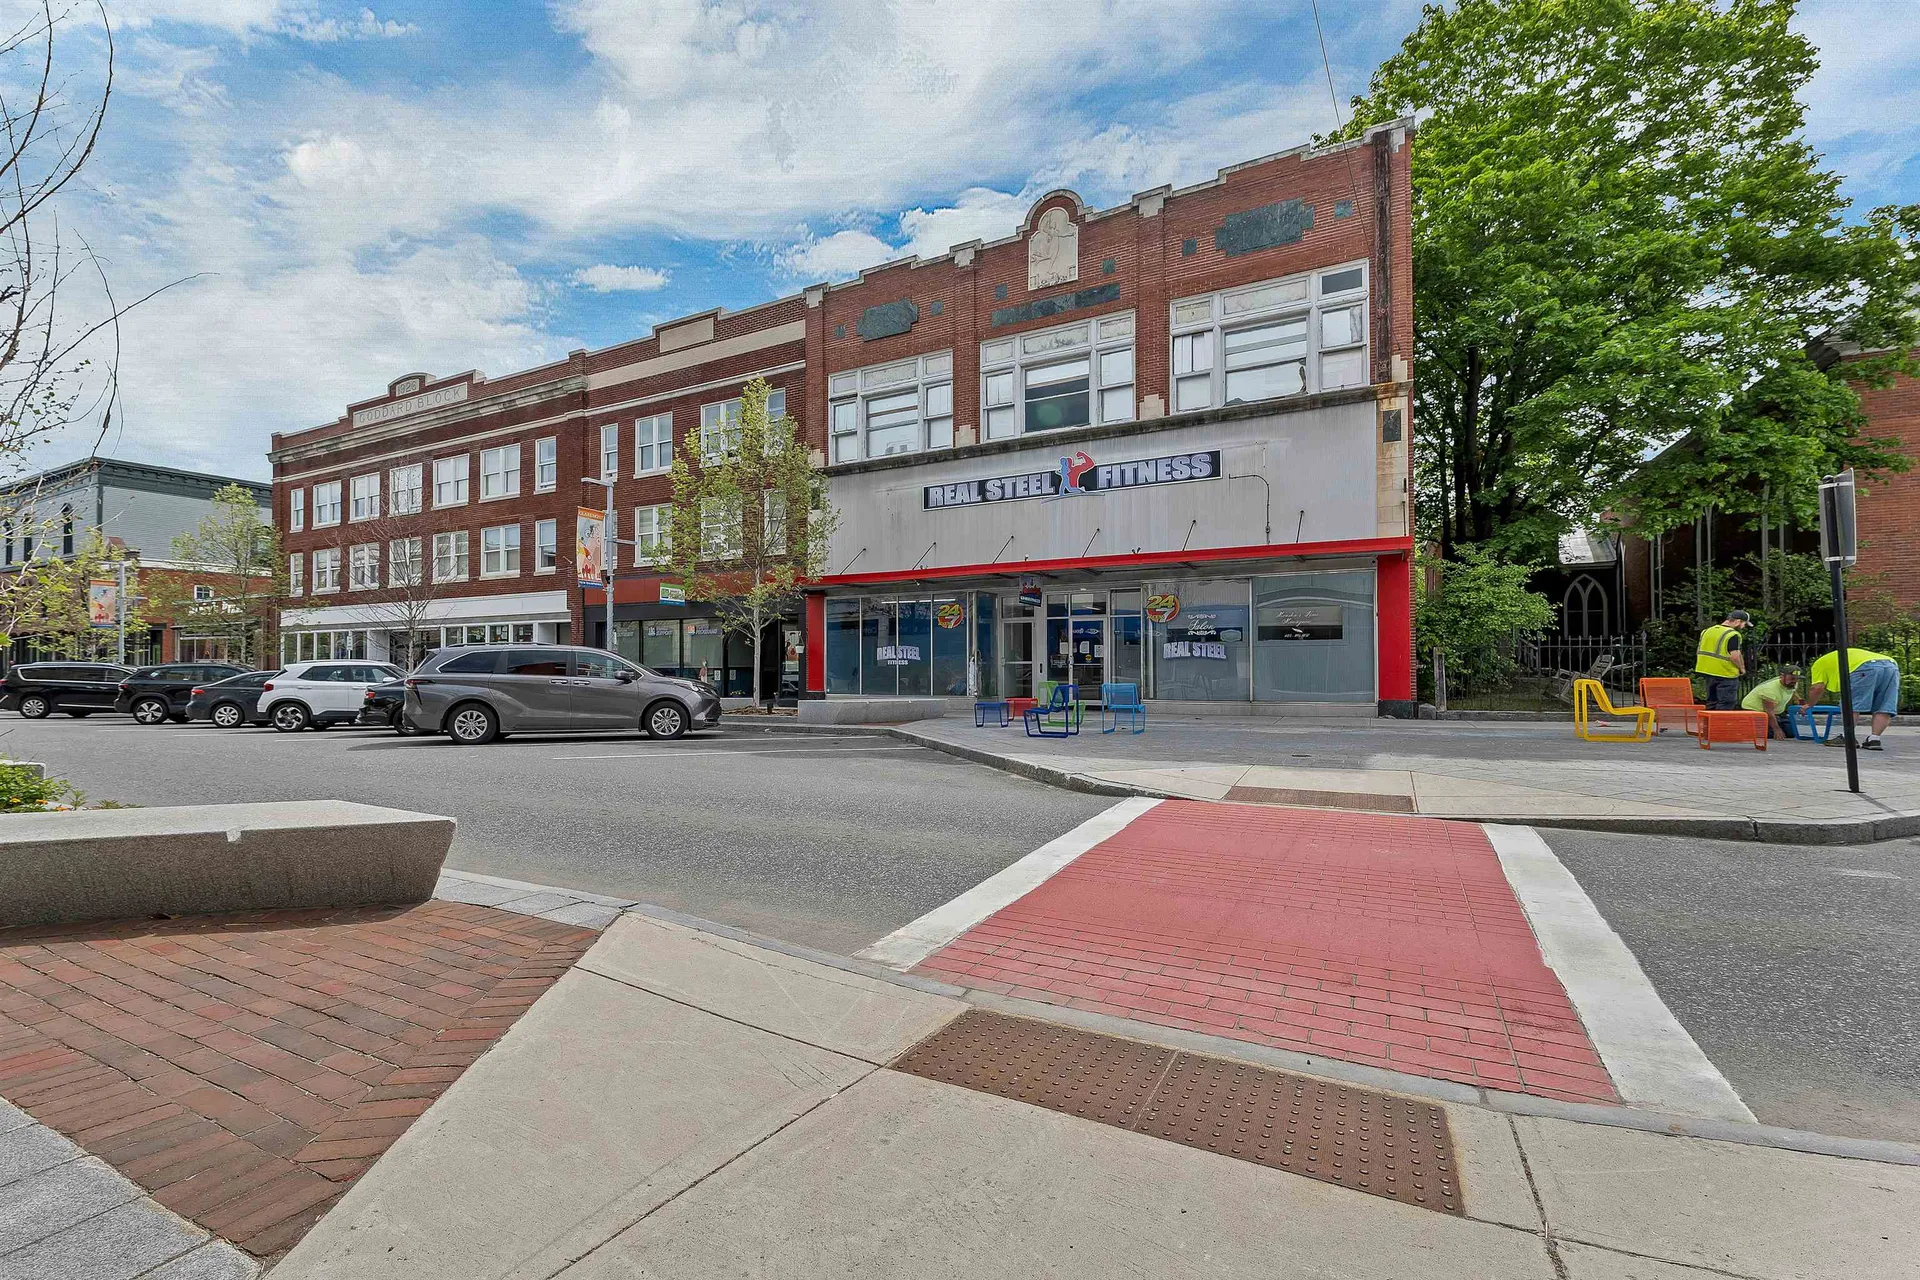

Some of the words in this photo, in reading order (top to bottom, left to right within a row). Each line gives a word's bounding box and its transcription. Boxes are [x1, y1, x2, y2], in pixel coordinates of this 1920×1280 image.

[359, 401, 412, 423] GODDARD
[417, 388, 461, 408] BLOCK
[928, 484, 982, 508] REAL
[984, 472, 1055, 501] STEEL
[1096, 452, 1212, 490] FITNESS
[1146, 594, 1175, 609] 24
[937, 604, 960, 617] 24
[1187, 618, 1216, 631] Salon
[876, 645, 896, 661] REAL
[896, 645, 921, 661] STEEL
[1163, 641, 1191, 659] REAL
[1192, 641, 1227, 659] STEEL
